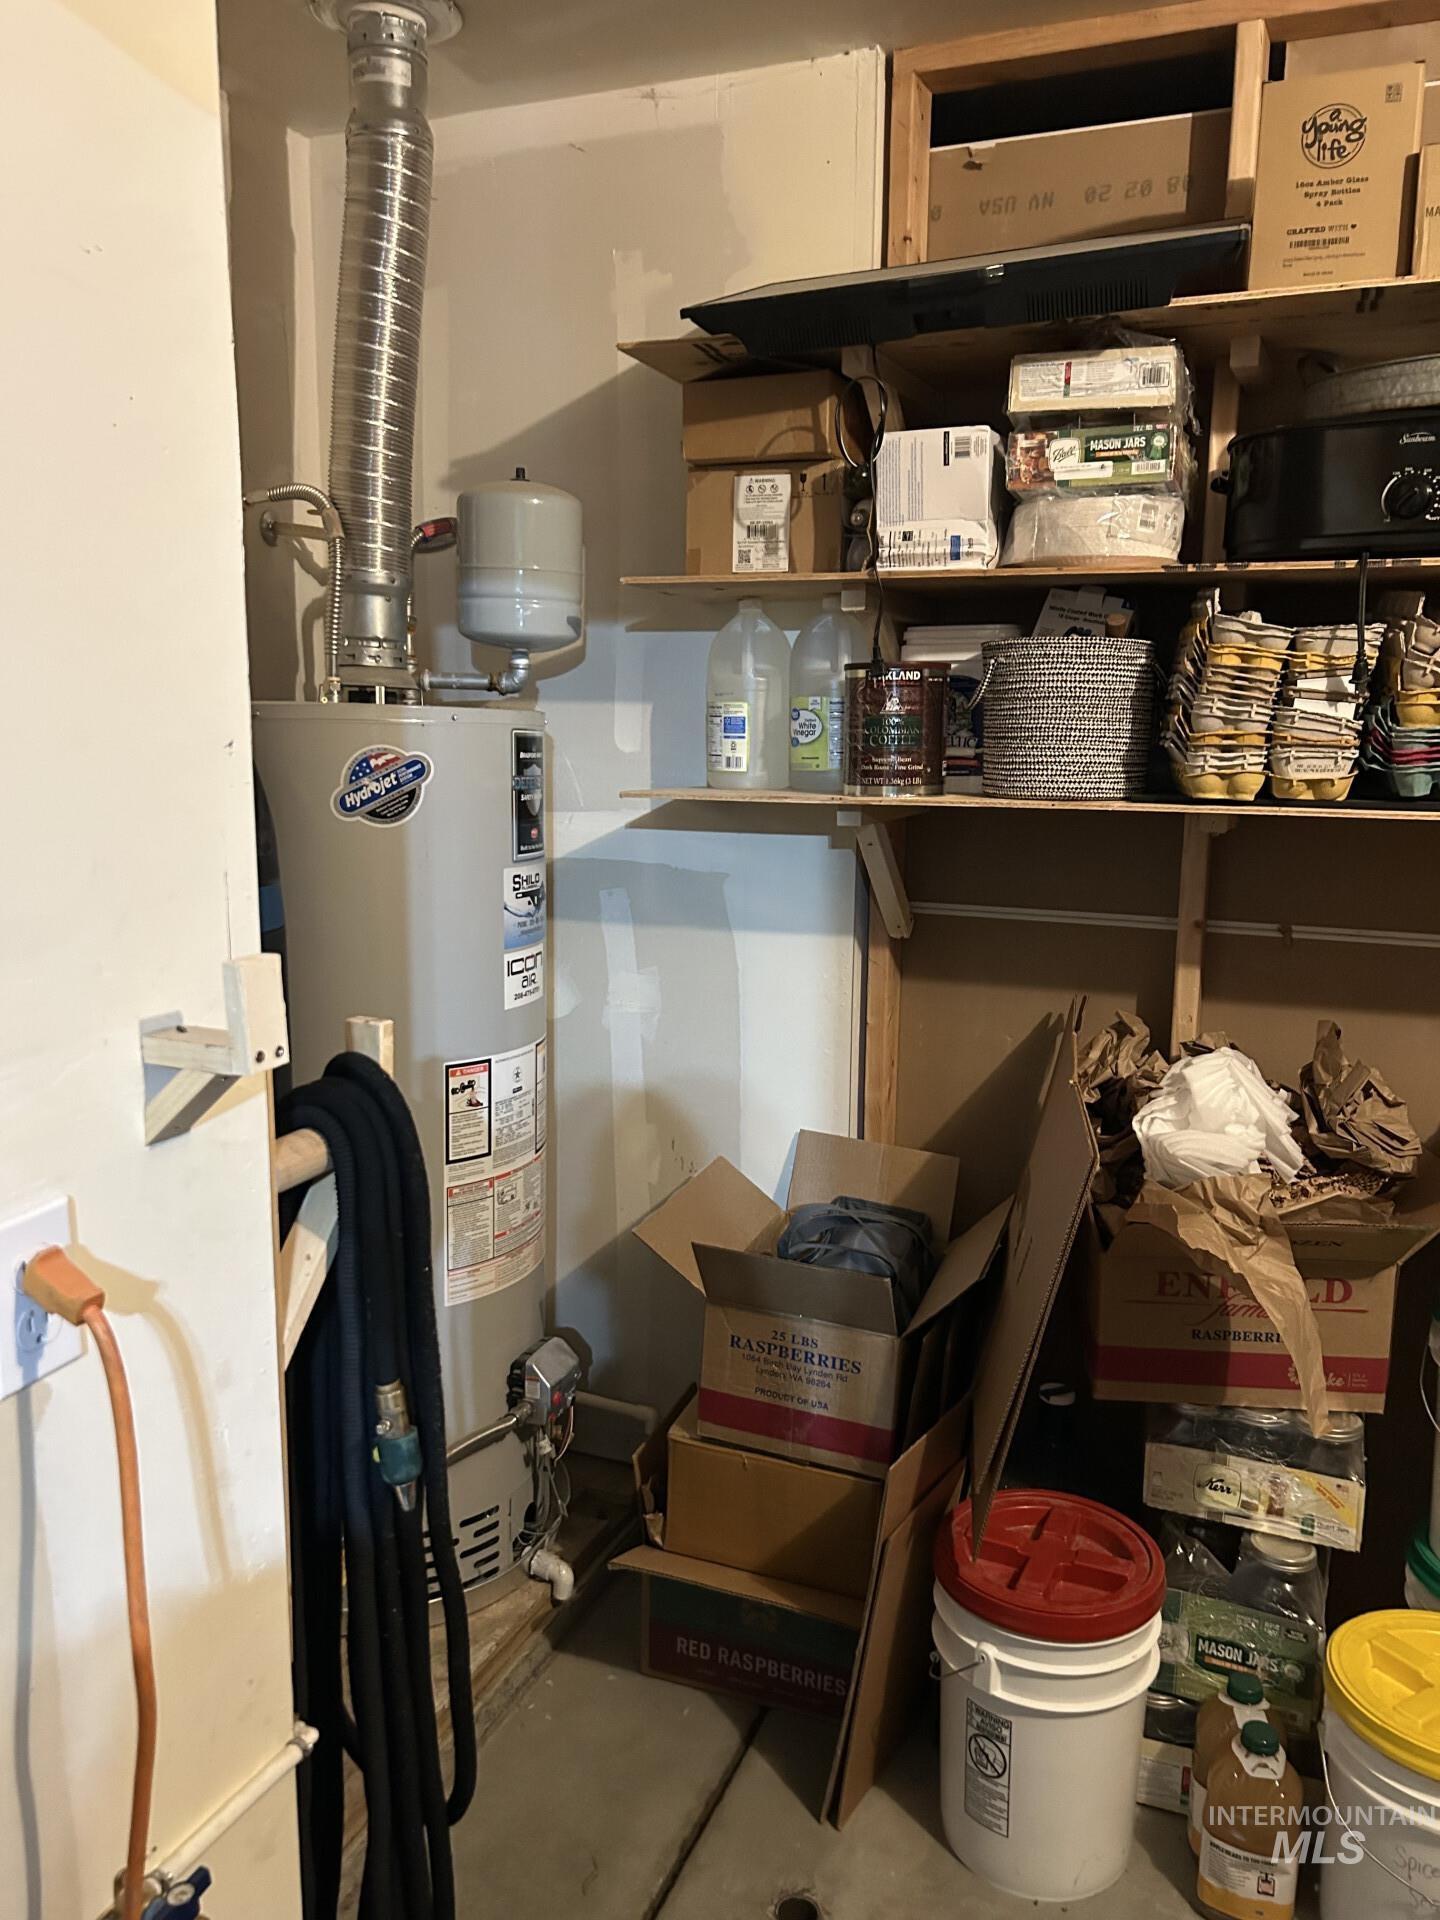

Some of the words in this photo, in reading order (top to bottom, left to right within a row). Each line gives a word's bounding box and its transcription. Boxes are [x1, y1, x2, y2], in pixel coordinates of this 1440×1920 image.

[1302, 114, 1367, 149] young
[1316, 139, 1351, 162] life
[1316, 177, 1343, 187] Amber
[1346, 175, 1369, 184] Glass
[1304, 189, 1328, 200] Spray
[1331, 187, 1361, 197] Bottles
[1324, 199, 1343, 208] Pack
[1286, 225, 1326, 236] CRAFTED
[1328, 223, 1349, 233] WITH
[1090, 438, 1122, 451] MASON
[1123, 436, 1146, 449] JARS
[1052, 446, 1077, 462] Ball
[793, 729, 817, 738] Vinegar
[798, 722, 817, 730] White
[864, 725, 920, 735] COLOMBIAN
[869, 735, 915, 746] COFFEE
[513, 873, 540, 892] SHILO
[1292, 1239, 1344, 1247] ZEN
[1157, 1271, 1353, 1304] ENFD
[771, 1330, 786, 1341] 25
[791, 1334, 818, 1349] LBS
[1192, 1329, 1284, 1343] RASPBERRI
[730, 1334, 861, 1374] RASPBERRIES
[790, 1373, 804, 1384] WA
[804, 1364, 834, 1379] Lynden
[836, 1371, 848, 1383] Rd
[754, 1386, 795, 1403] PRODUCT
[798, 1396, 809, 1406] OF
[810, 1399, 829, 1411] USA
[1204, 1476, 1233, 1495] Kerr
[1198, 1638, 1243, 1664] MASON
[1245, 1652, 1280, 1674] JARS
[676, 1636, 711, 1661] RED
[718, 1647, 848, 1696] RASPBERRIES
